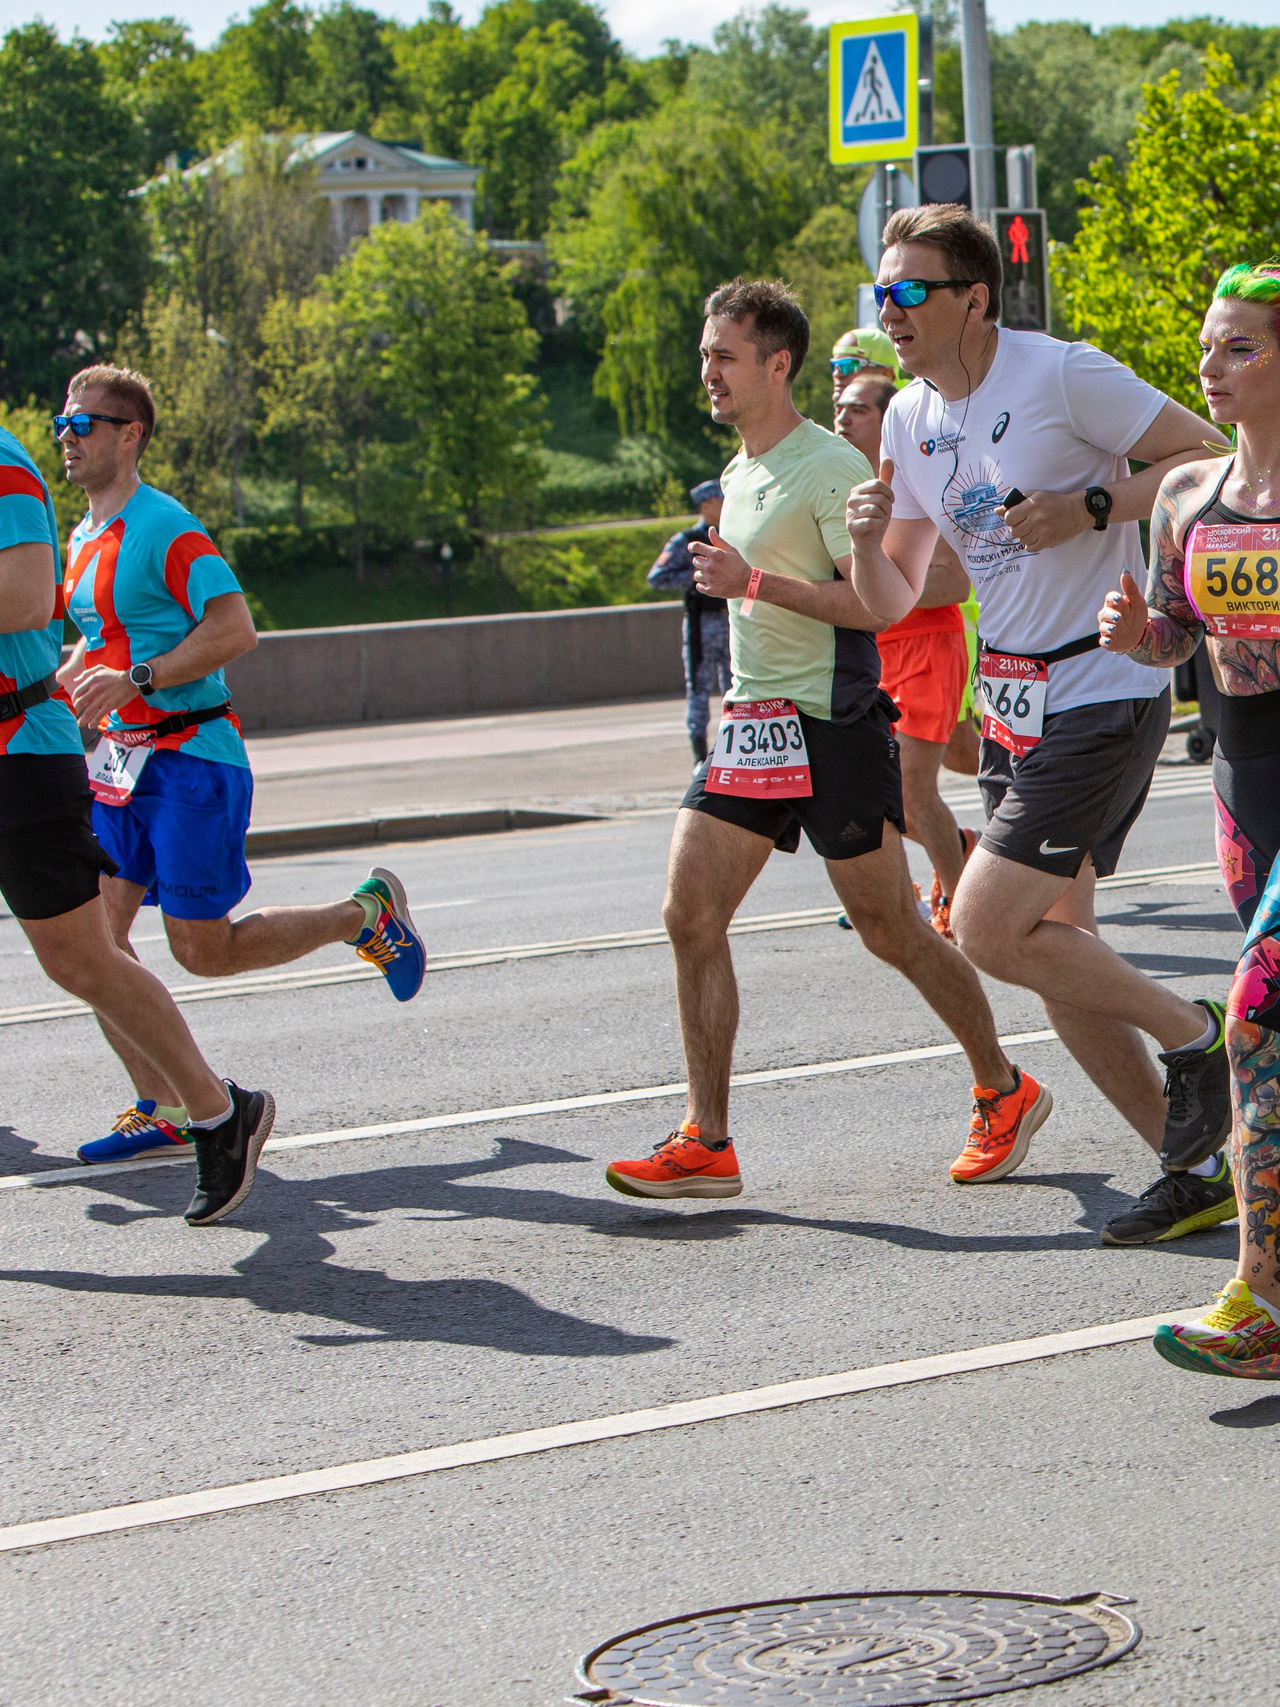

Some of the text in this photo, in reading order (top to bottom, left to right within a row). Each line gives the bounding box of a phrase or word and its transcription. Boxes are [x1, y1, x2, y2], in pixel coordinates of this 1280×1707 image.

[1207, 526, 1251, 536] МОСКОВСКИЙ
[1005, 564, 1020, 574] 2018
[723, 720, 803, 754] 13403
[736, 755, 789, 766] АЛЕКСАНДР
[718, 769, 733, 785] E
